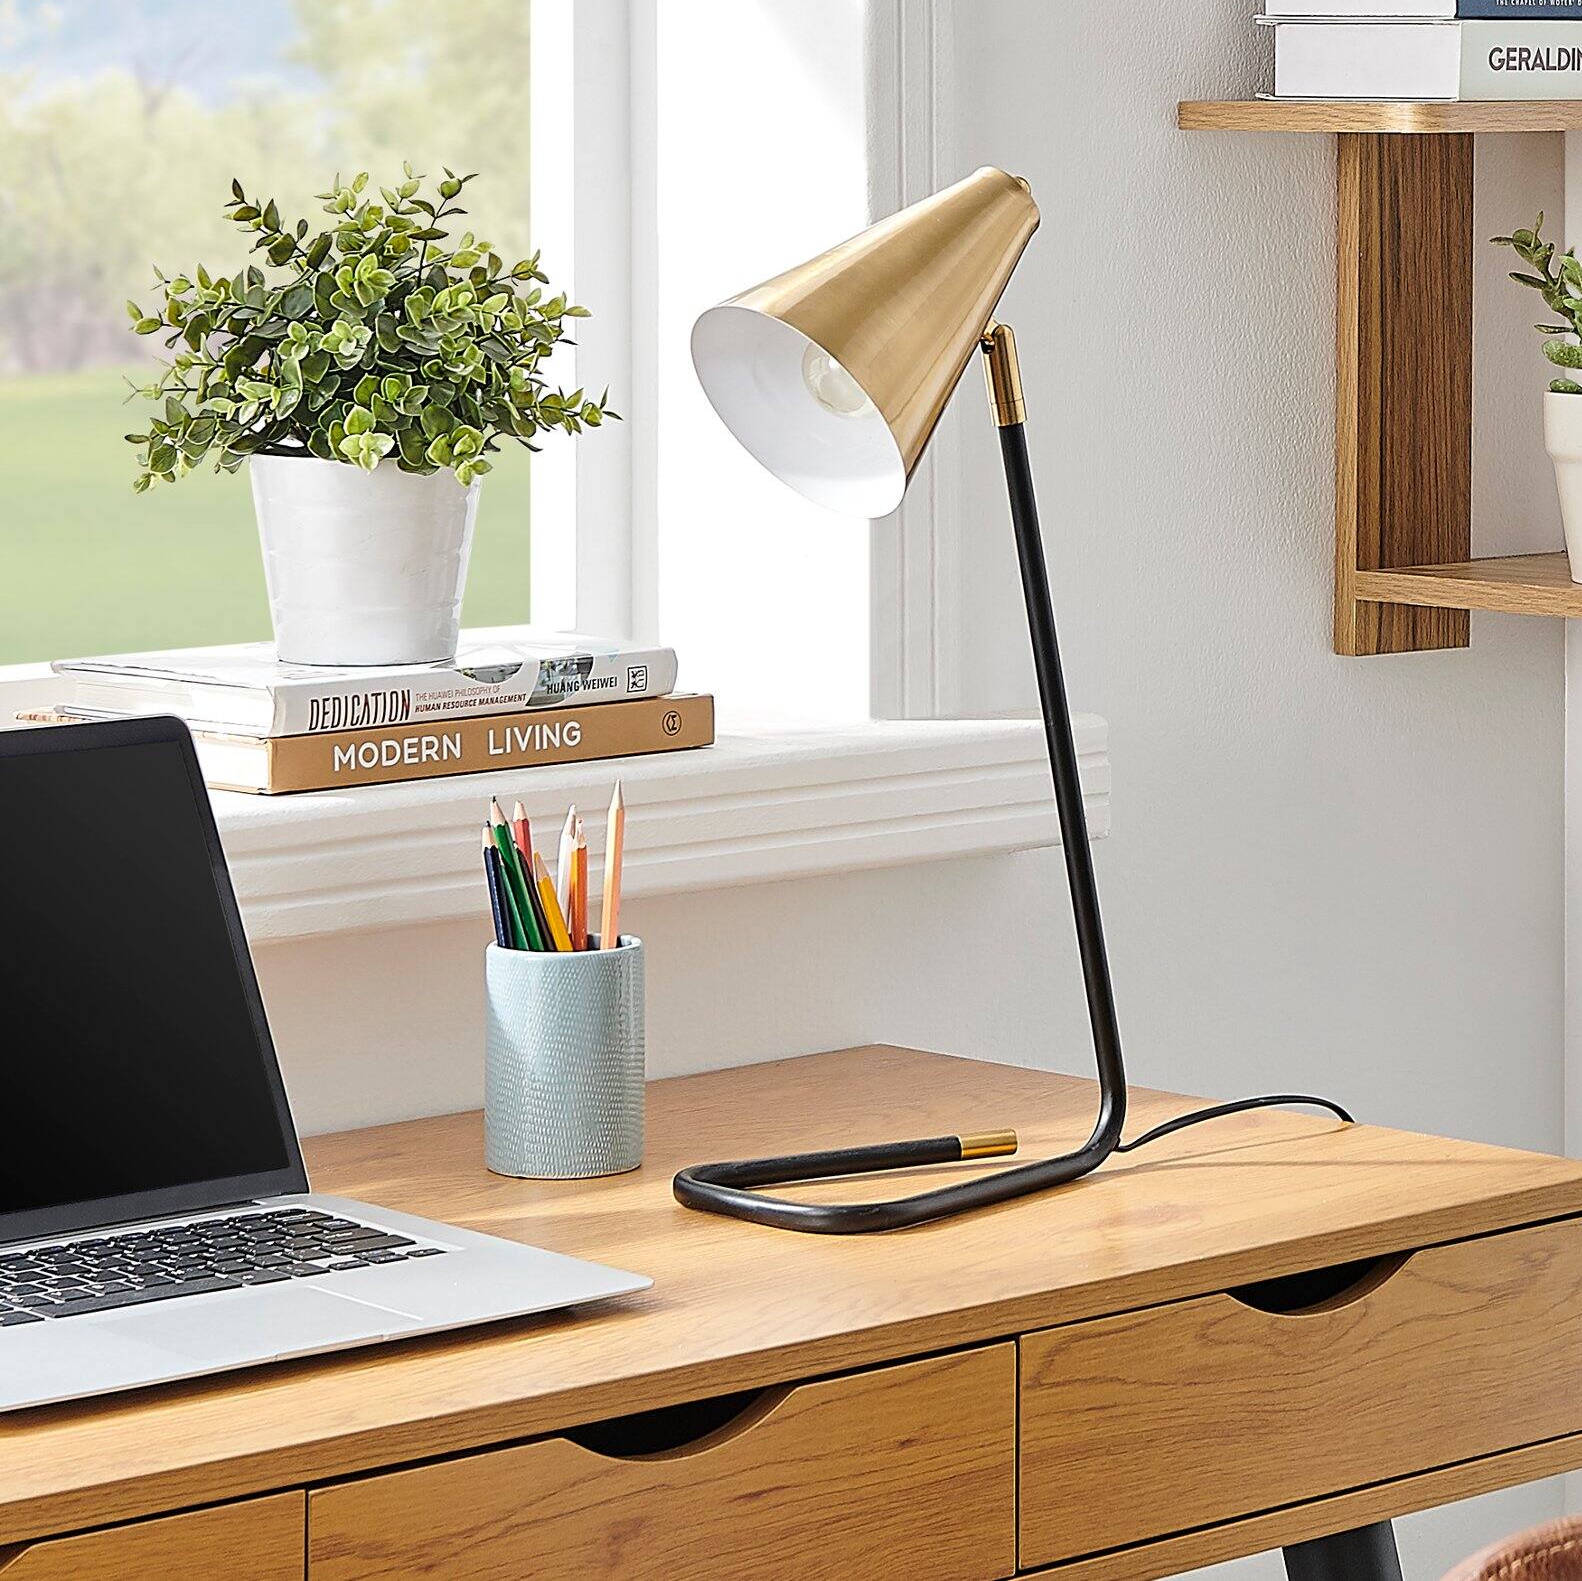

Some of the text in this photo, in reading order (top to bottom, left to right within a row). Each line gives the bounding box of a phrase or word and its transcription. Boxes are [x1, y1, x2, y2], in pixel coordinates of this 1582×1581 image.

[416, 692, 428, 701] THE
[428, 689, 454, 700] HUAWEI
[454, 686, 492, 698] PHILOSOPHY
[546, 681, 580, 694] HUANG
[582, 677, 618, 690] WEIWEI
[309, 689, 411, 731] DEDICATION
[415, 693, 527, 713] HUMAN RESOURCE MANAGEMENT
[333, 721, 582, 772] MODERN LIVING
